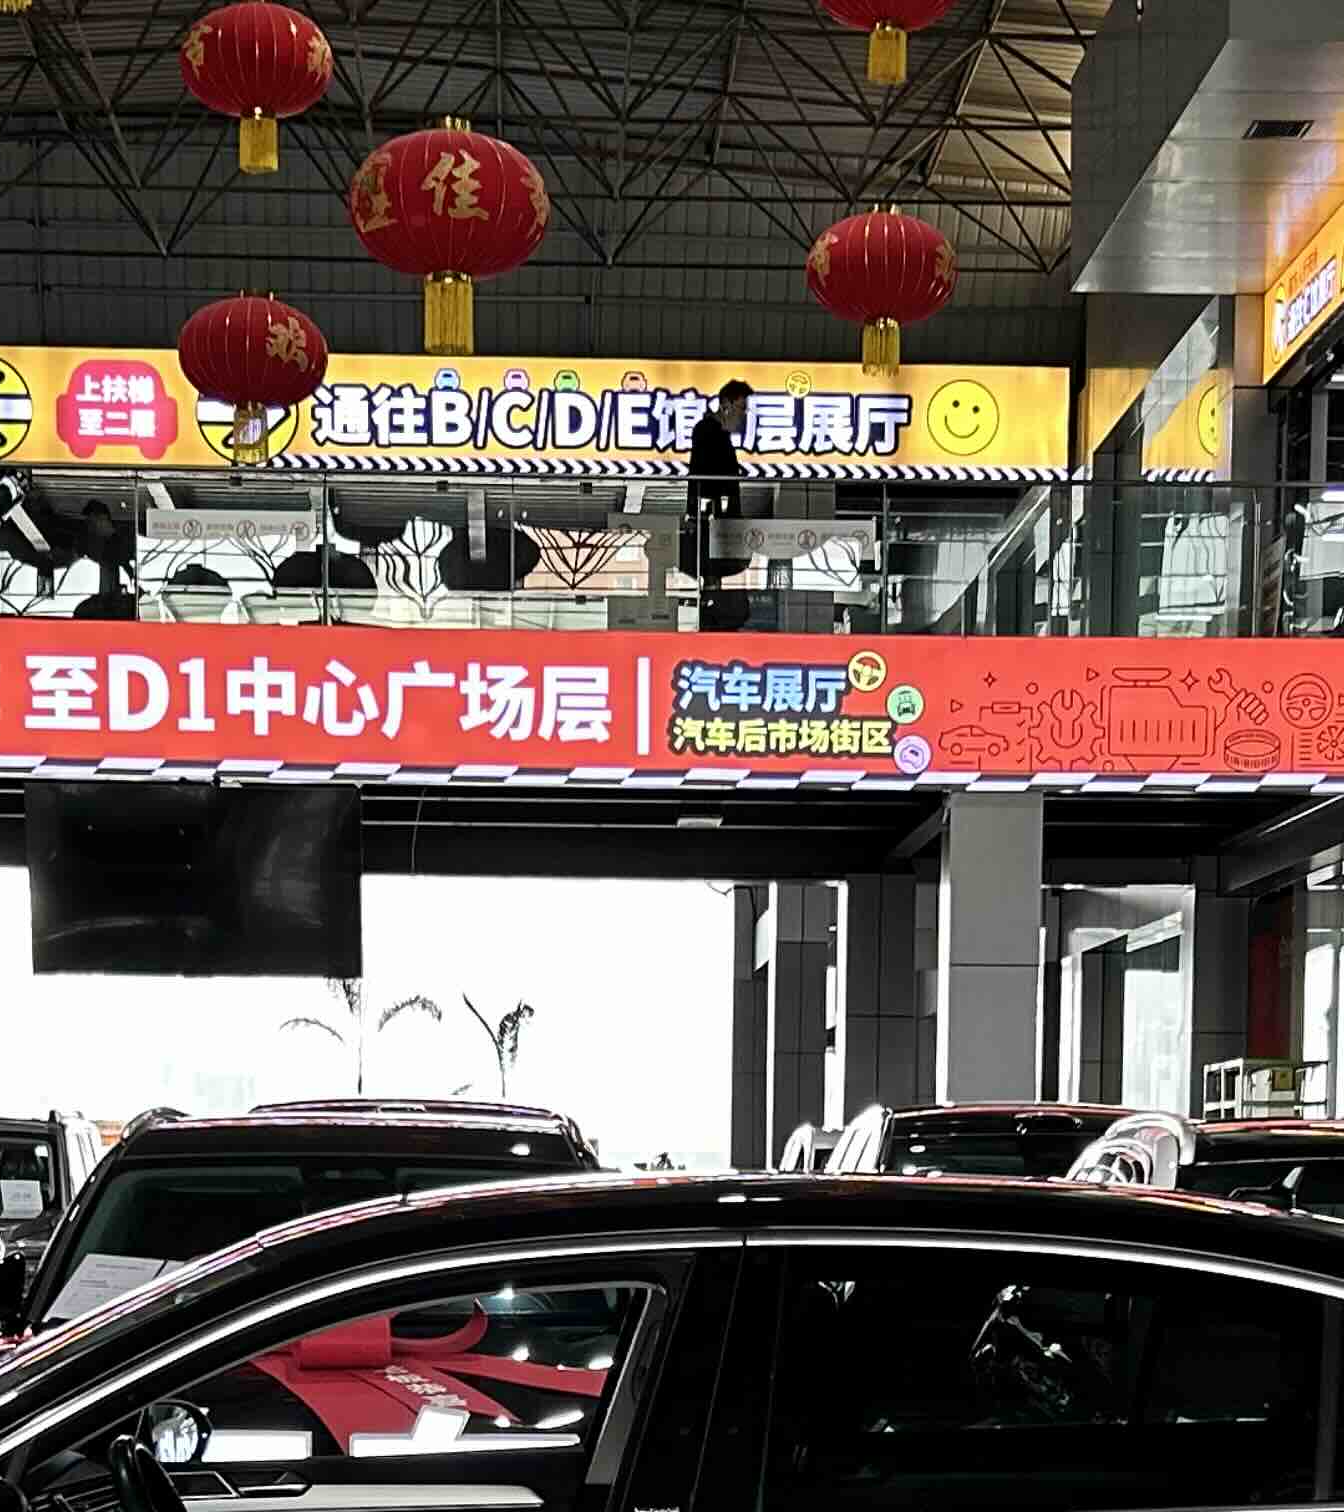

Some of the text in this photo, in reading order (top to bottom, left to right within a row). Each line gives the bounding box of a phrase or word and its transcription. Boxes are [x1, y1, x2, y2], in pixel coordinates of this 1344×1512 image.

[422, 150, 489, 220] 佳
[313, 383, 911, 454] 通往B/C/D/E馆层展厅
[23, 653, 613, 743] 至D1中心广场层
[677, 665, 848, 713] 汽车展厅
[672, 717, 893, 753] 汽车后市场街区
